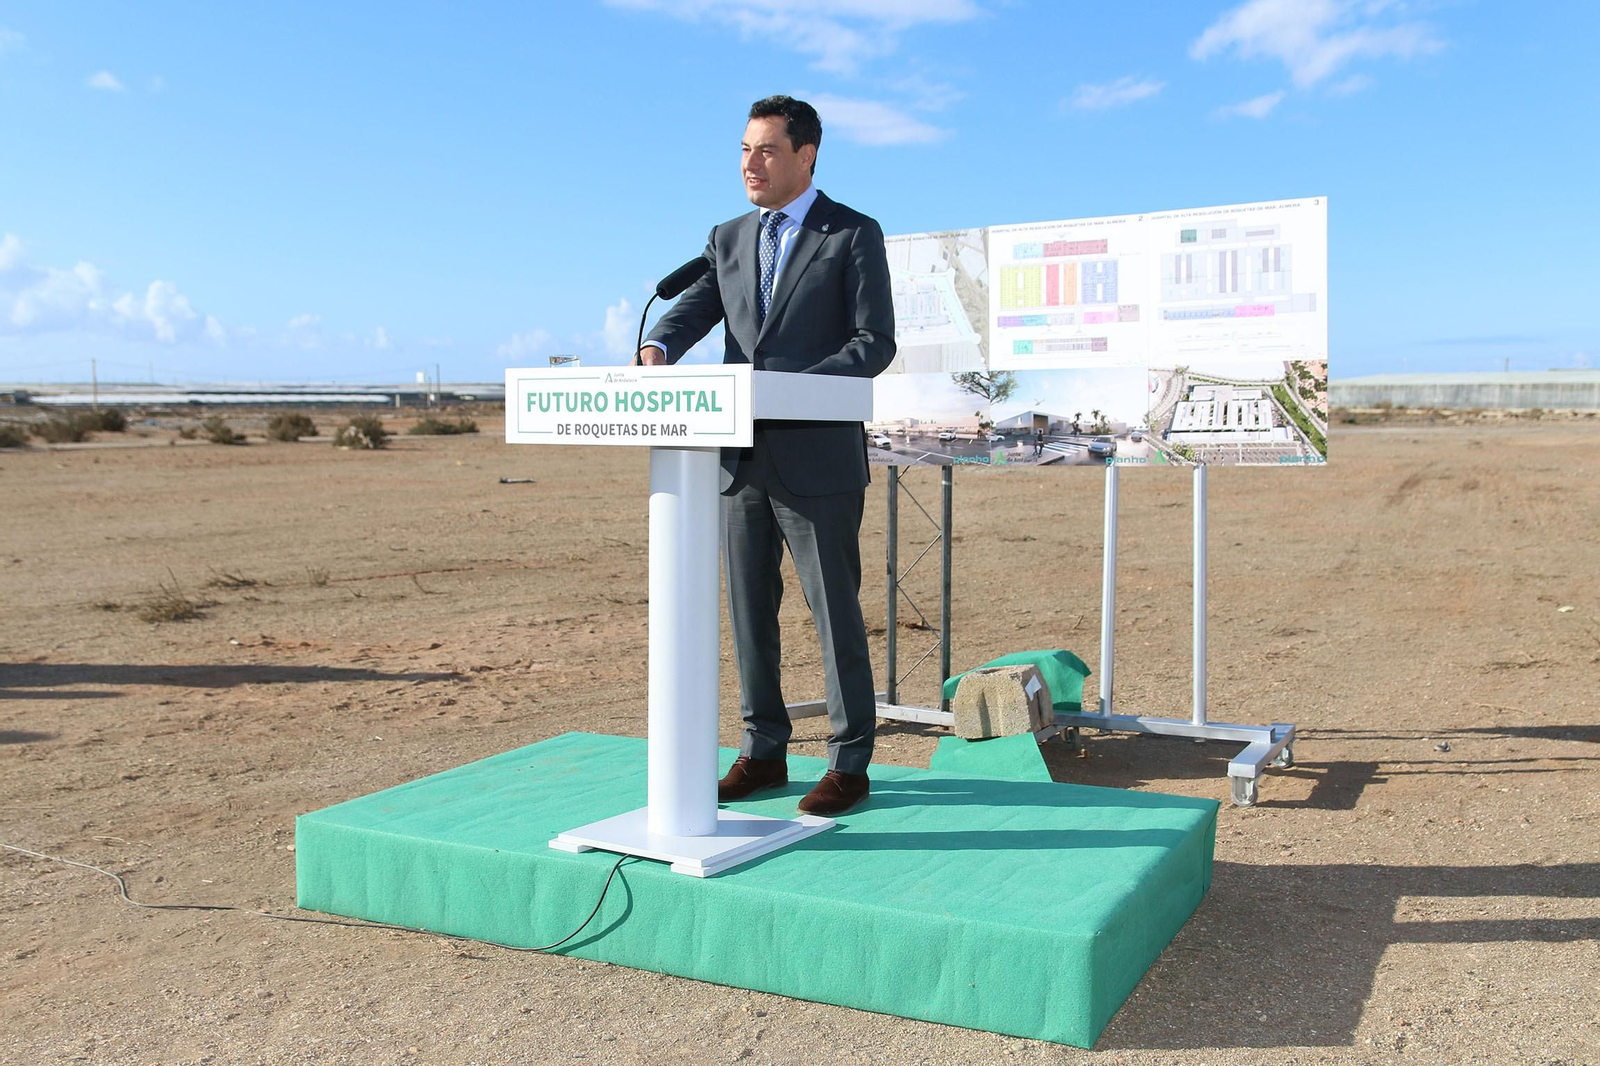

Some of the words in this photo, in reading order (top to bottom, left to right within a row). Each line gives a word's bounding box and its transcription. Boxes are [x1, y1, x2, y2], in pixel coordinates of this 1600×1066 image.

[527, 391, 609, 412] FUTURO
[615, 390, 723, 412] HOSPITAL
[557, 423, 572, 436] DE
[574, 423, 638, 438] ROQUETAS
[641, 424, 657, 436] DE
[660, 424, 688, 437] MAR
[1104, 456, 1146, 465] planho
[1279, 454, 1326, 464] planho
